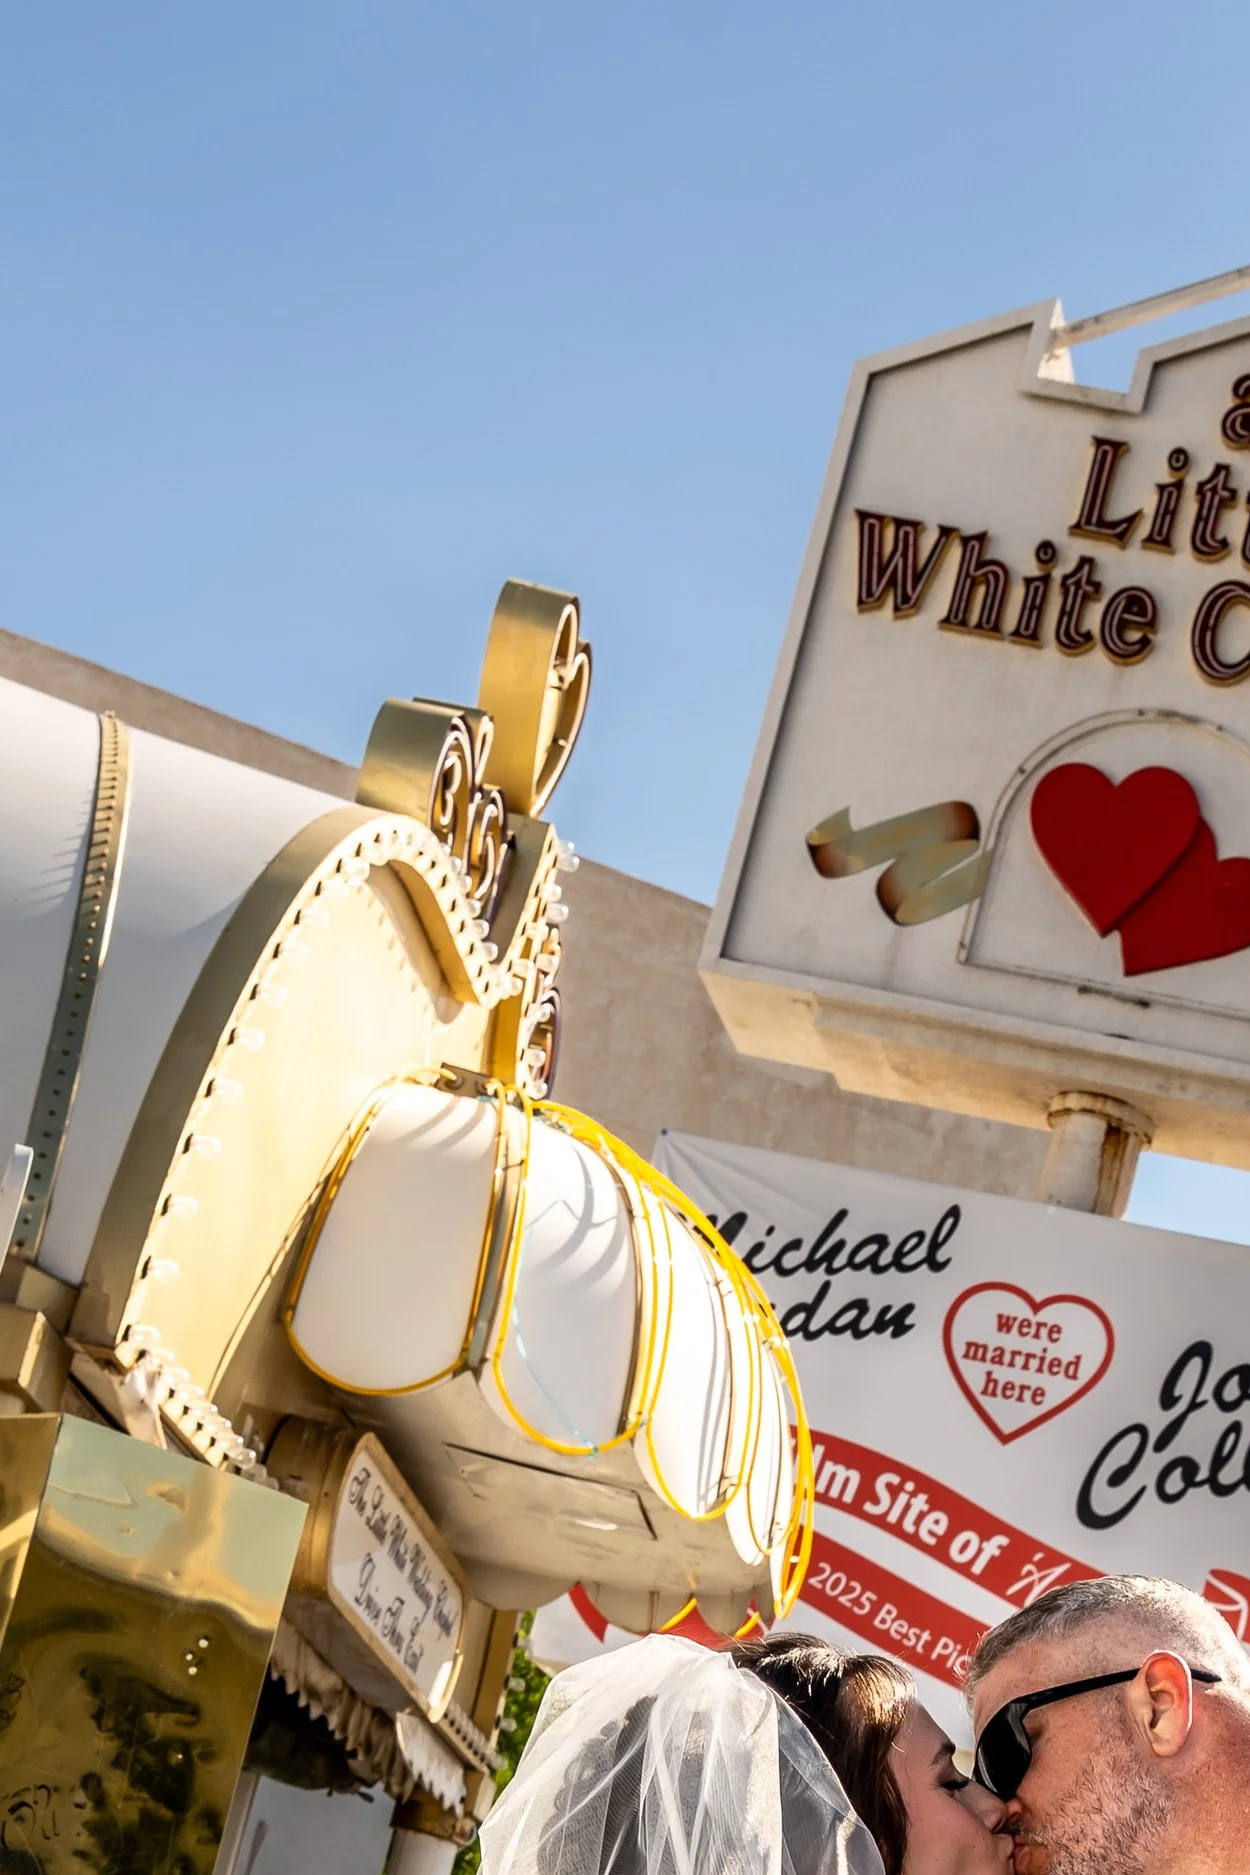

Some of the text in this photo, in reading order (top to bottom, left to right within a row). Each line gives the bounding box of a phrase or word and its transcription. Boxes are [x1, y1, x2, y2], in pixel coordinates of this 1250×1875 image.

[854, 508, 1158, 666] White
[770, 1280, 916, 1341] dan
[997, 1313, 1062, 1343] were
[962, 1340, 1082, 1381] married
[981, 1370, 1046, 1406] here
[863, 1472, 949, 1546] Site
[949, 1530, 1010, 1576] of
[808, 1562, 878, 1617] 2025
[873, 1603, 932, 1654] Best
